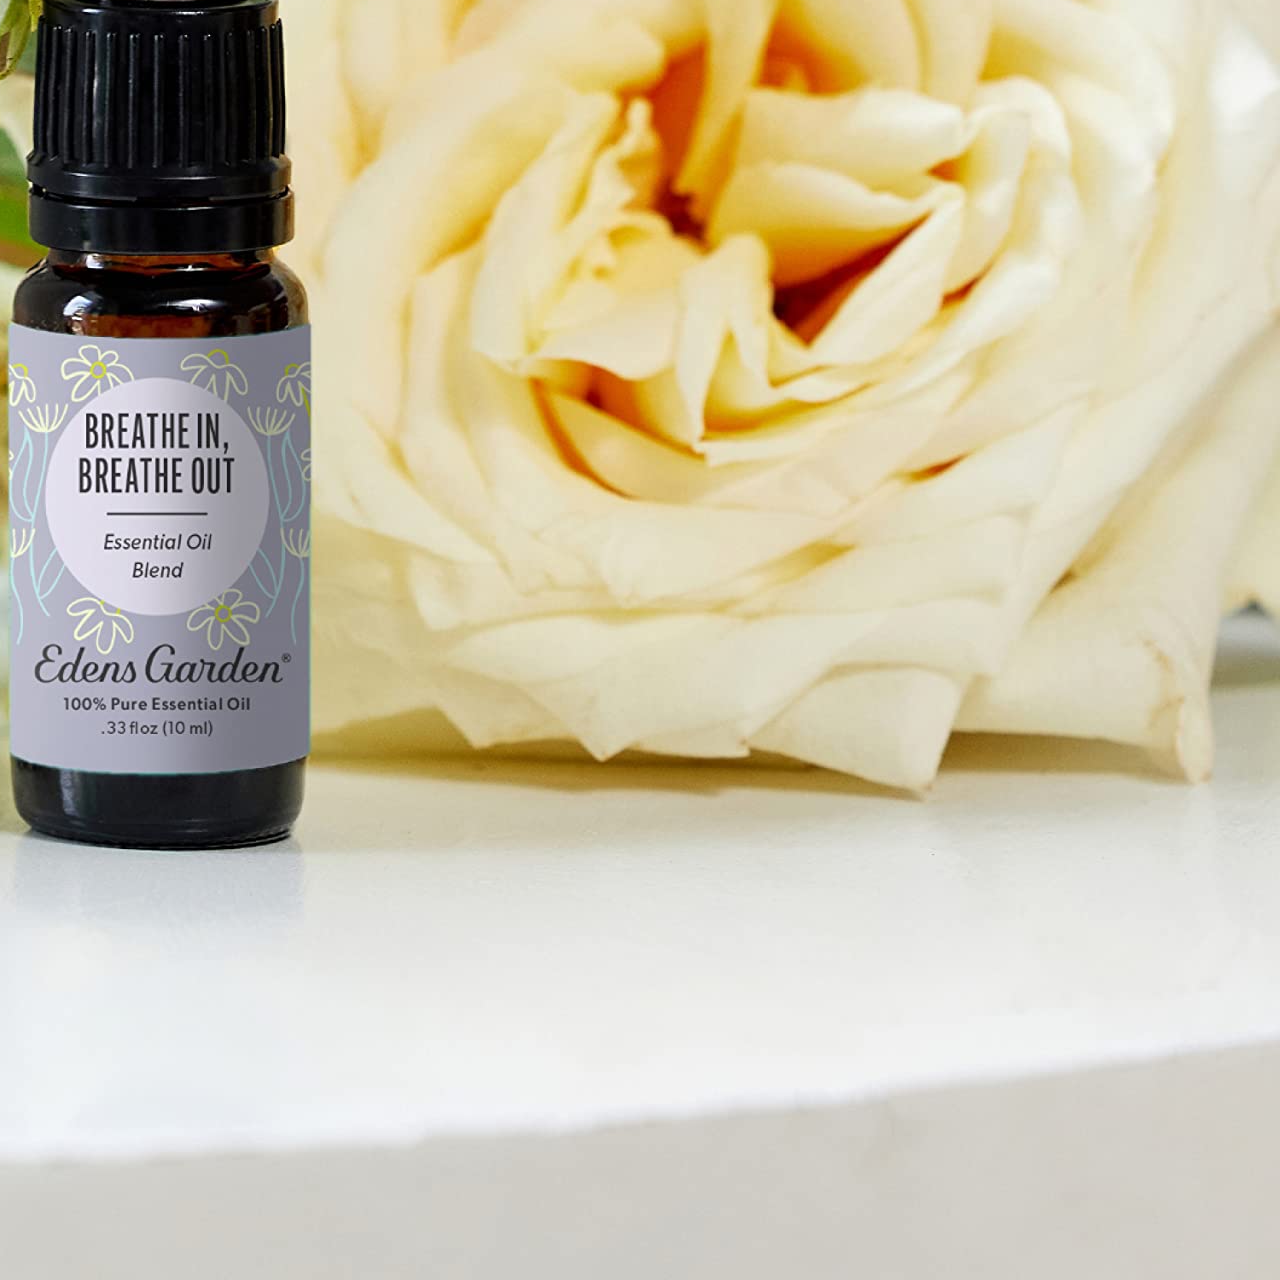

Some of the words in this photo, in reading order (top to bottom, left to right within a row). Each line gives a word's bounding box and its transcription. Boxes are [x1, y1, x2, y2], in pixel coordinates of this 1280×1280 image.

[85, 413, 190, 449] BREATHE
[197, 413, 229, 454] IN,
[79, 457, 183, 493] BREATHE
[191, 457, 235, 493] OUT
[103, 533, 182, 551] Essential
[186, 533, 212, 551] Oil
[132, 562, 184, 578] Blend
[34, 643, 137, 683] Edens
[64, 697, 107, 711] 100%
[111, 697, 148, 711] Pure
[152, 697, 222, 711] Essential
[227, 697, 250, 711] Oil
[101, 721, 126, 735] .33
[162, 720, 185, 737] (10
[189, 720, 213, 737] ml)
